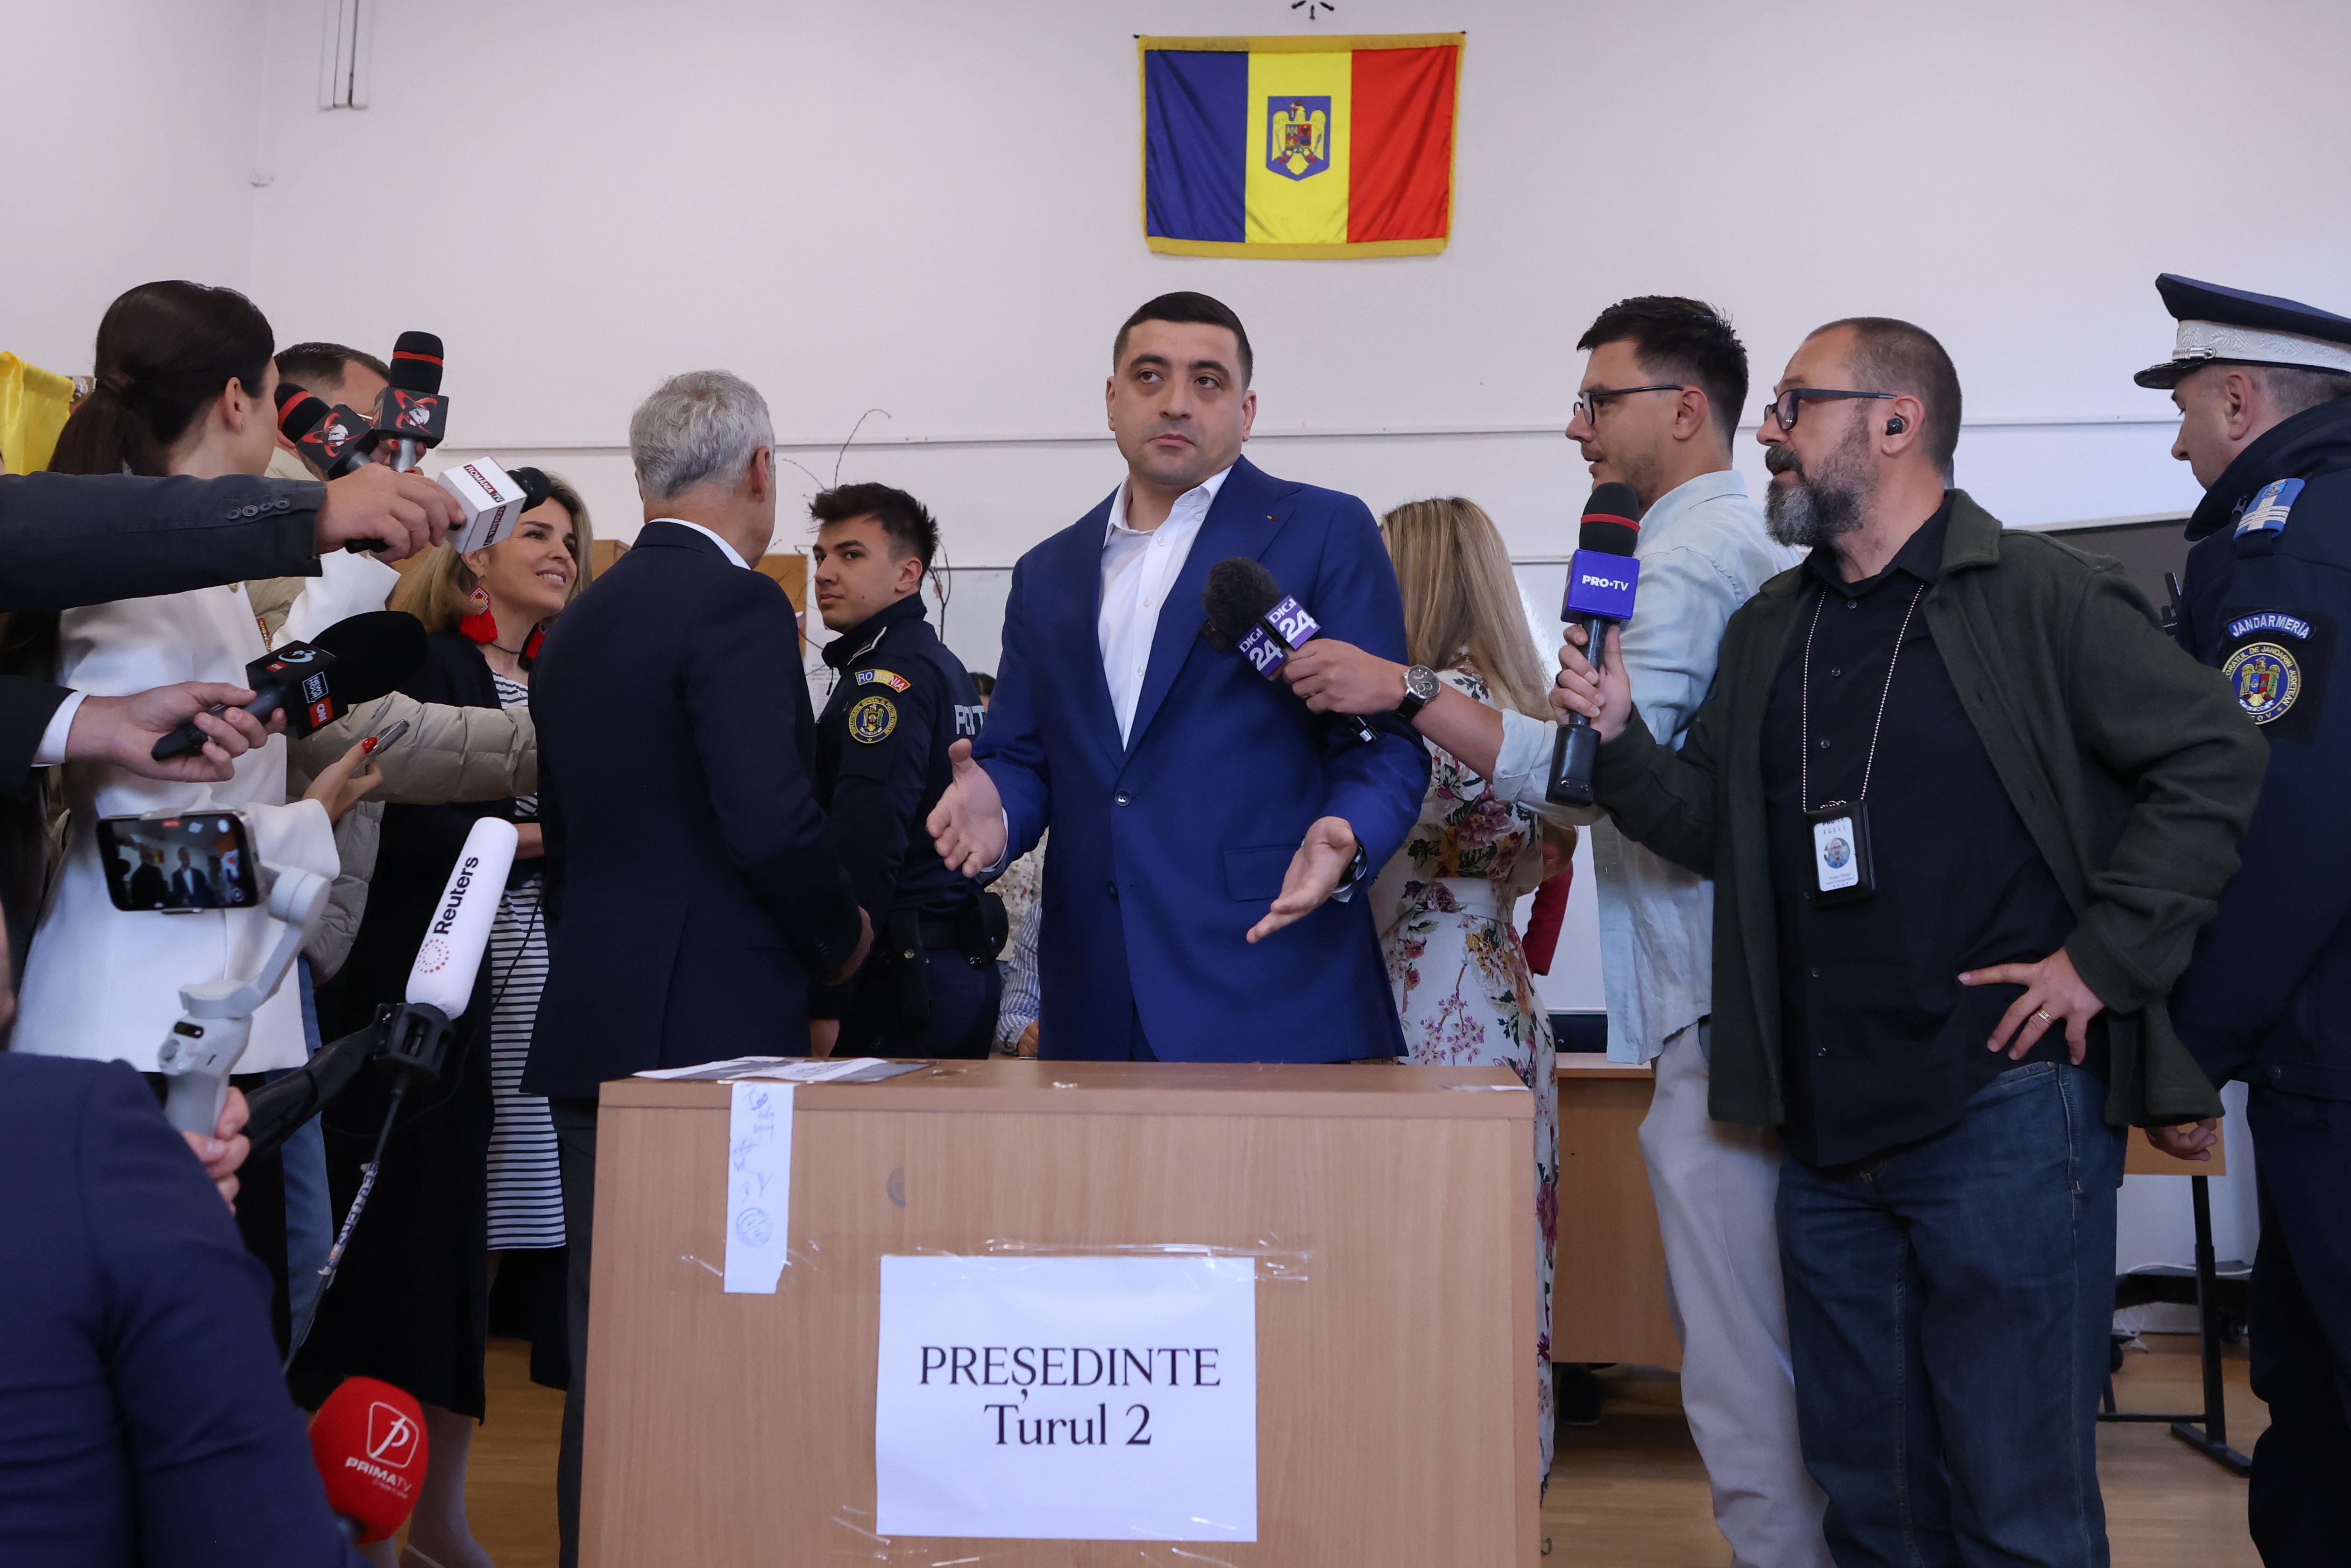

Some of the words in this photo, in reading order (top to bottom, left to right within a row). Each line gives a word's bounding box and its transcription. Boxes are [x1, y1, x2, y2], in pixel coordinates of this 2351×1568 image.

[1269, 598, 1297, 624] DIGI
[1279, 610, 1317, 643] 24
[2232, 615, 2310, 639] JANDARMERIA
[1239, 628, 1264, 653] DIGI
[1249, 639, 1283, 672] 24
[2261, 646, 2294, 667] JANDARMI
[858, 671, 905, 691] ROMANIA
[316, 703, 327, 723] CNN
[433, 857, 479, 935] Reuters
[919, 1346, 1222, 1404] PREȘEDINTE
[984, 1403, 1108, 1446] Turul
[1125, 1404, 1152, 1446] 2
